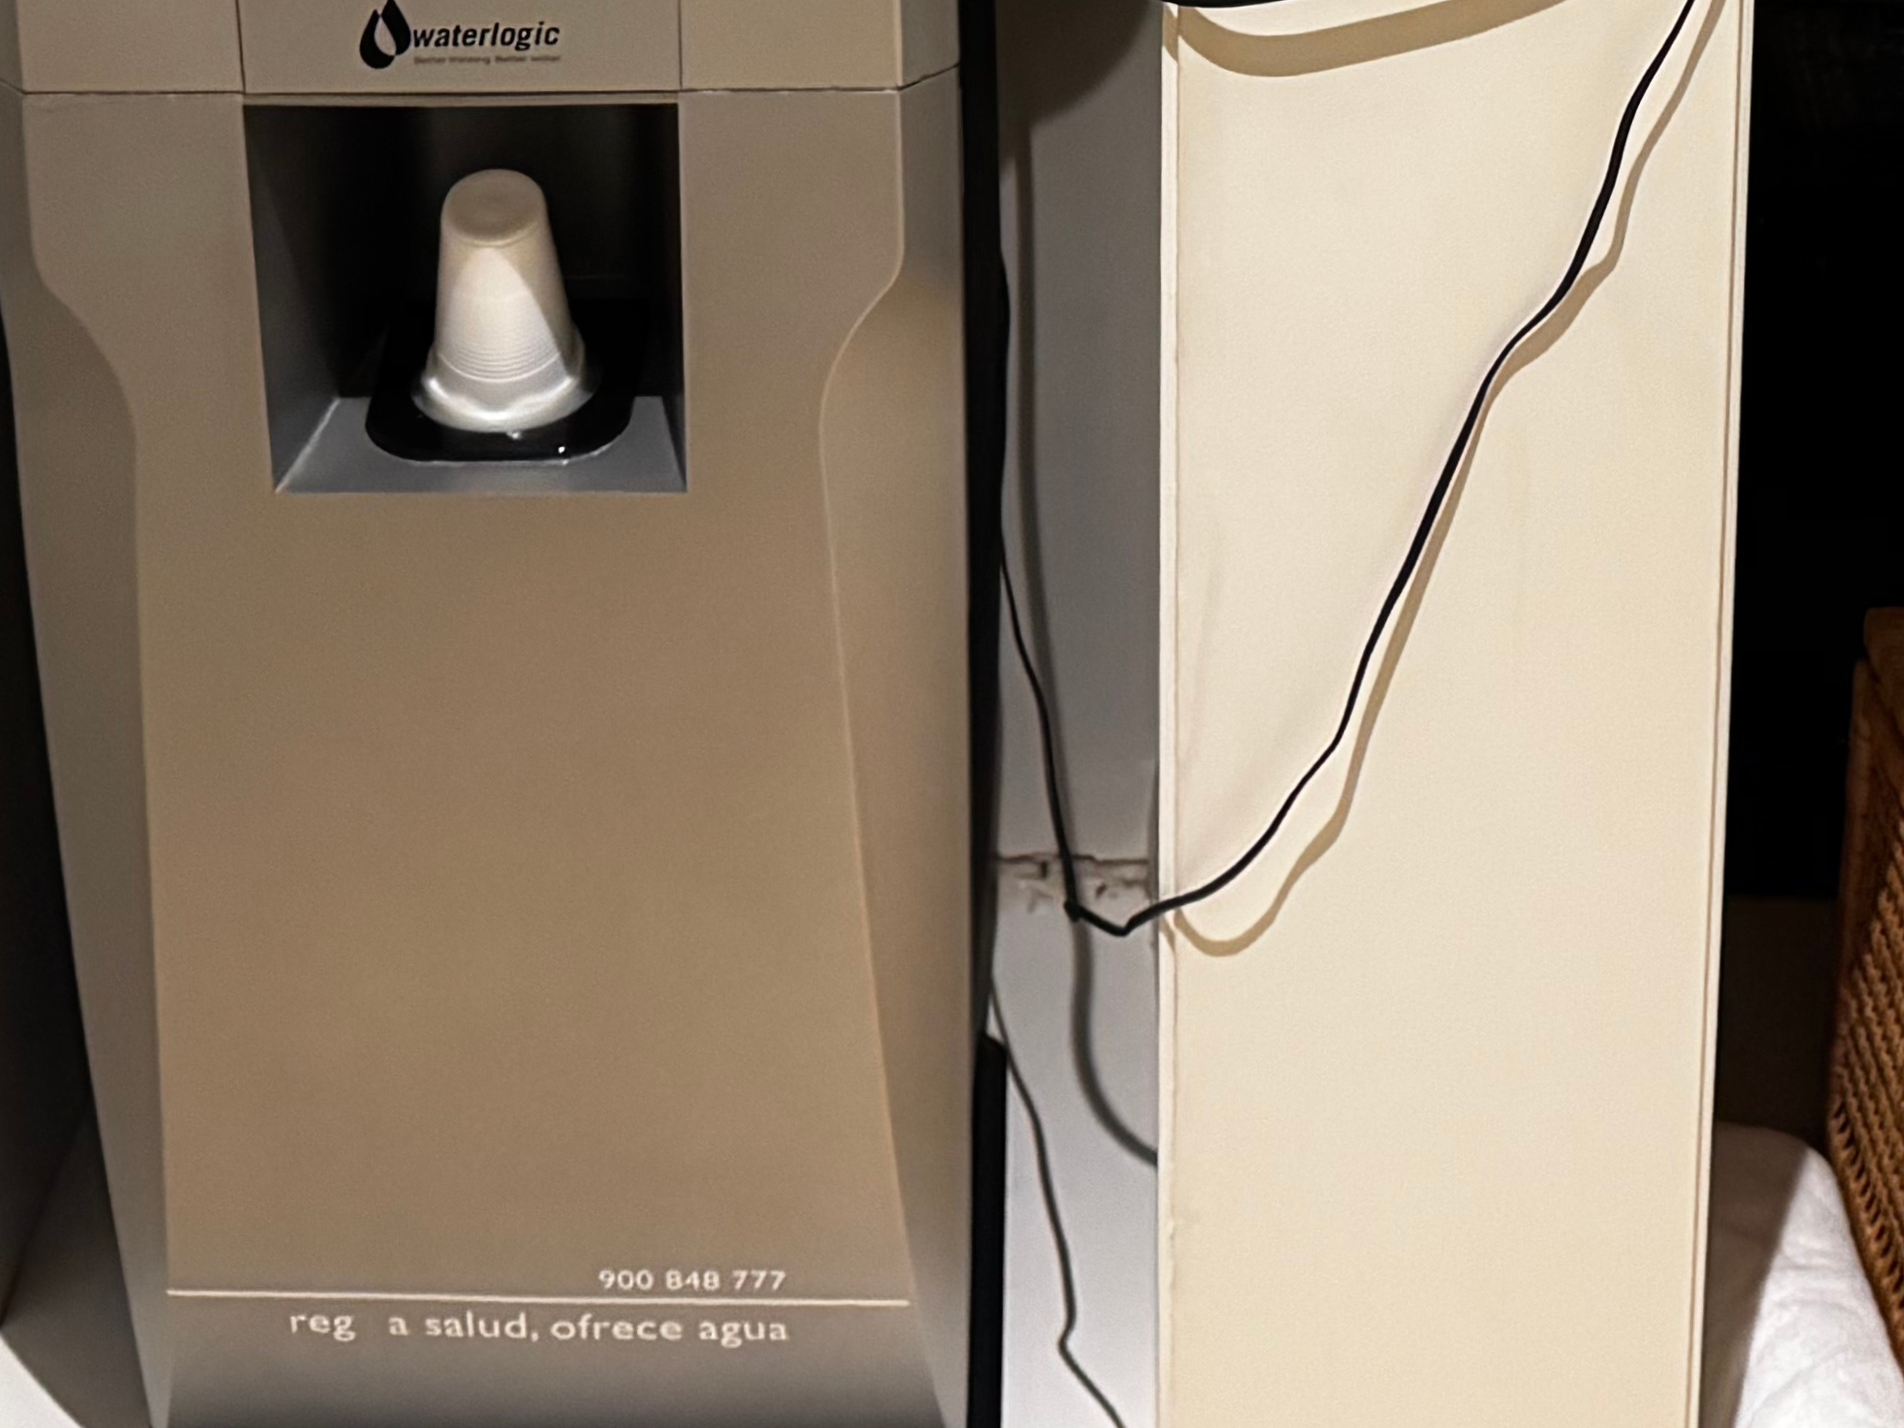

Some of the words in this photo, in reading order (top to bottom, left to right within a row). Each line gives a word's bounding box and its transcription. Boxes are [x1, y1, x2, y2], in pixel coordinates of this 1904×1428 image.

[412, 20, 560, 52] waterlogic
[598, 1269, 654, 1291] 900
[665, 1269, 721, 1292] 848
[732, 1269, 786, 1291] 777
[424, 1309, 540, 1343] salud,
[550, 1313, 684, 1341] ofrece
[698, 1321, 789, 1349] agua
